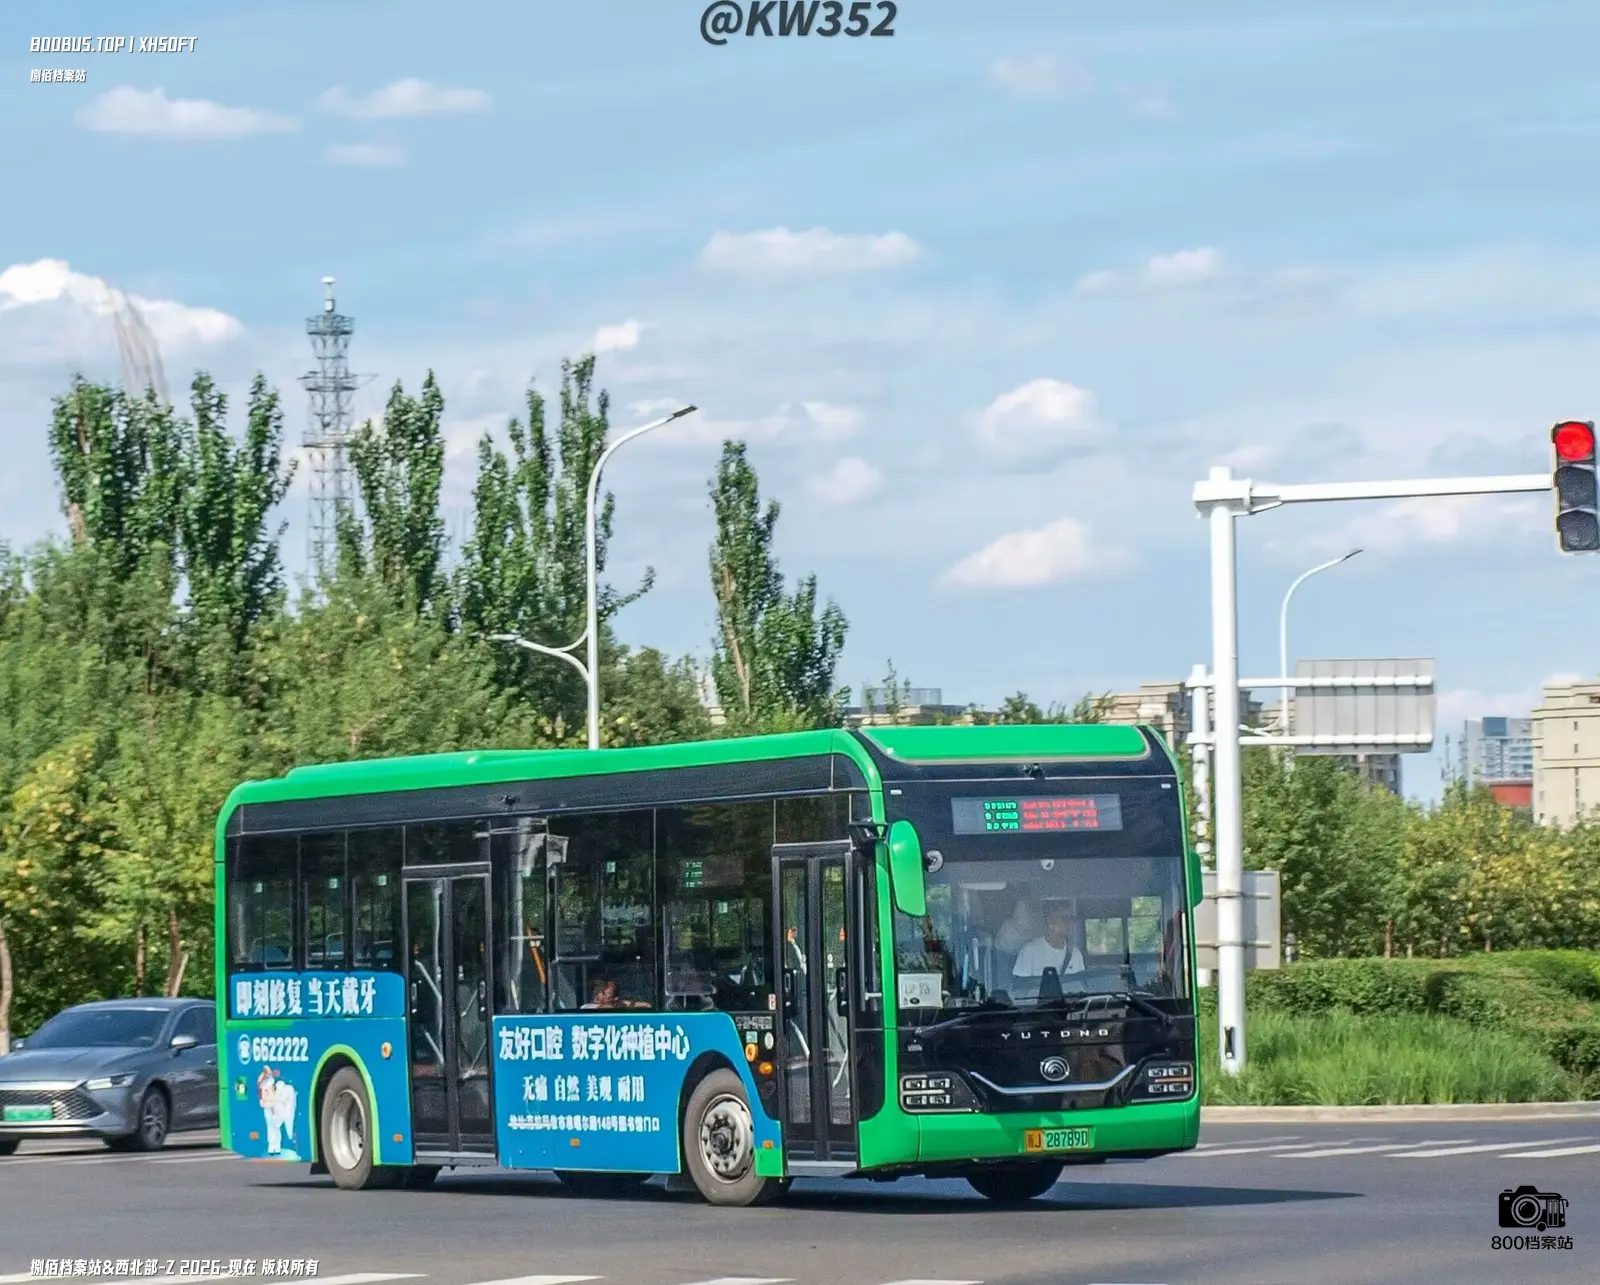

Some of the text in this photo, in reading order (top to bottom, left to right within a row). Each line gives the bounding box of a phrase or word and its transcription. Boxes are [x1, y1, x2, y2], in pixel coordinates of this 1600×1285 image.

[308, 976, 377, 1015] 当天戴牙
[499, 1024, 690, 1061] 友好口腔 数字化种植中心
[1001, 1028, 1109, 1040] YUTONG
[252, 1036, 310, 1062] 6622222
[554, 1074, 581, 1102] 自然
[617, 1075, 645, 1102] 耐用
